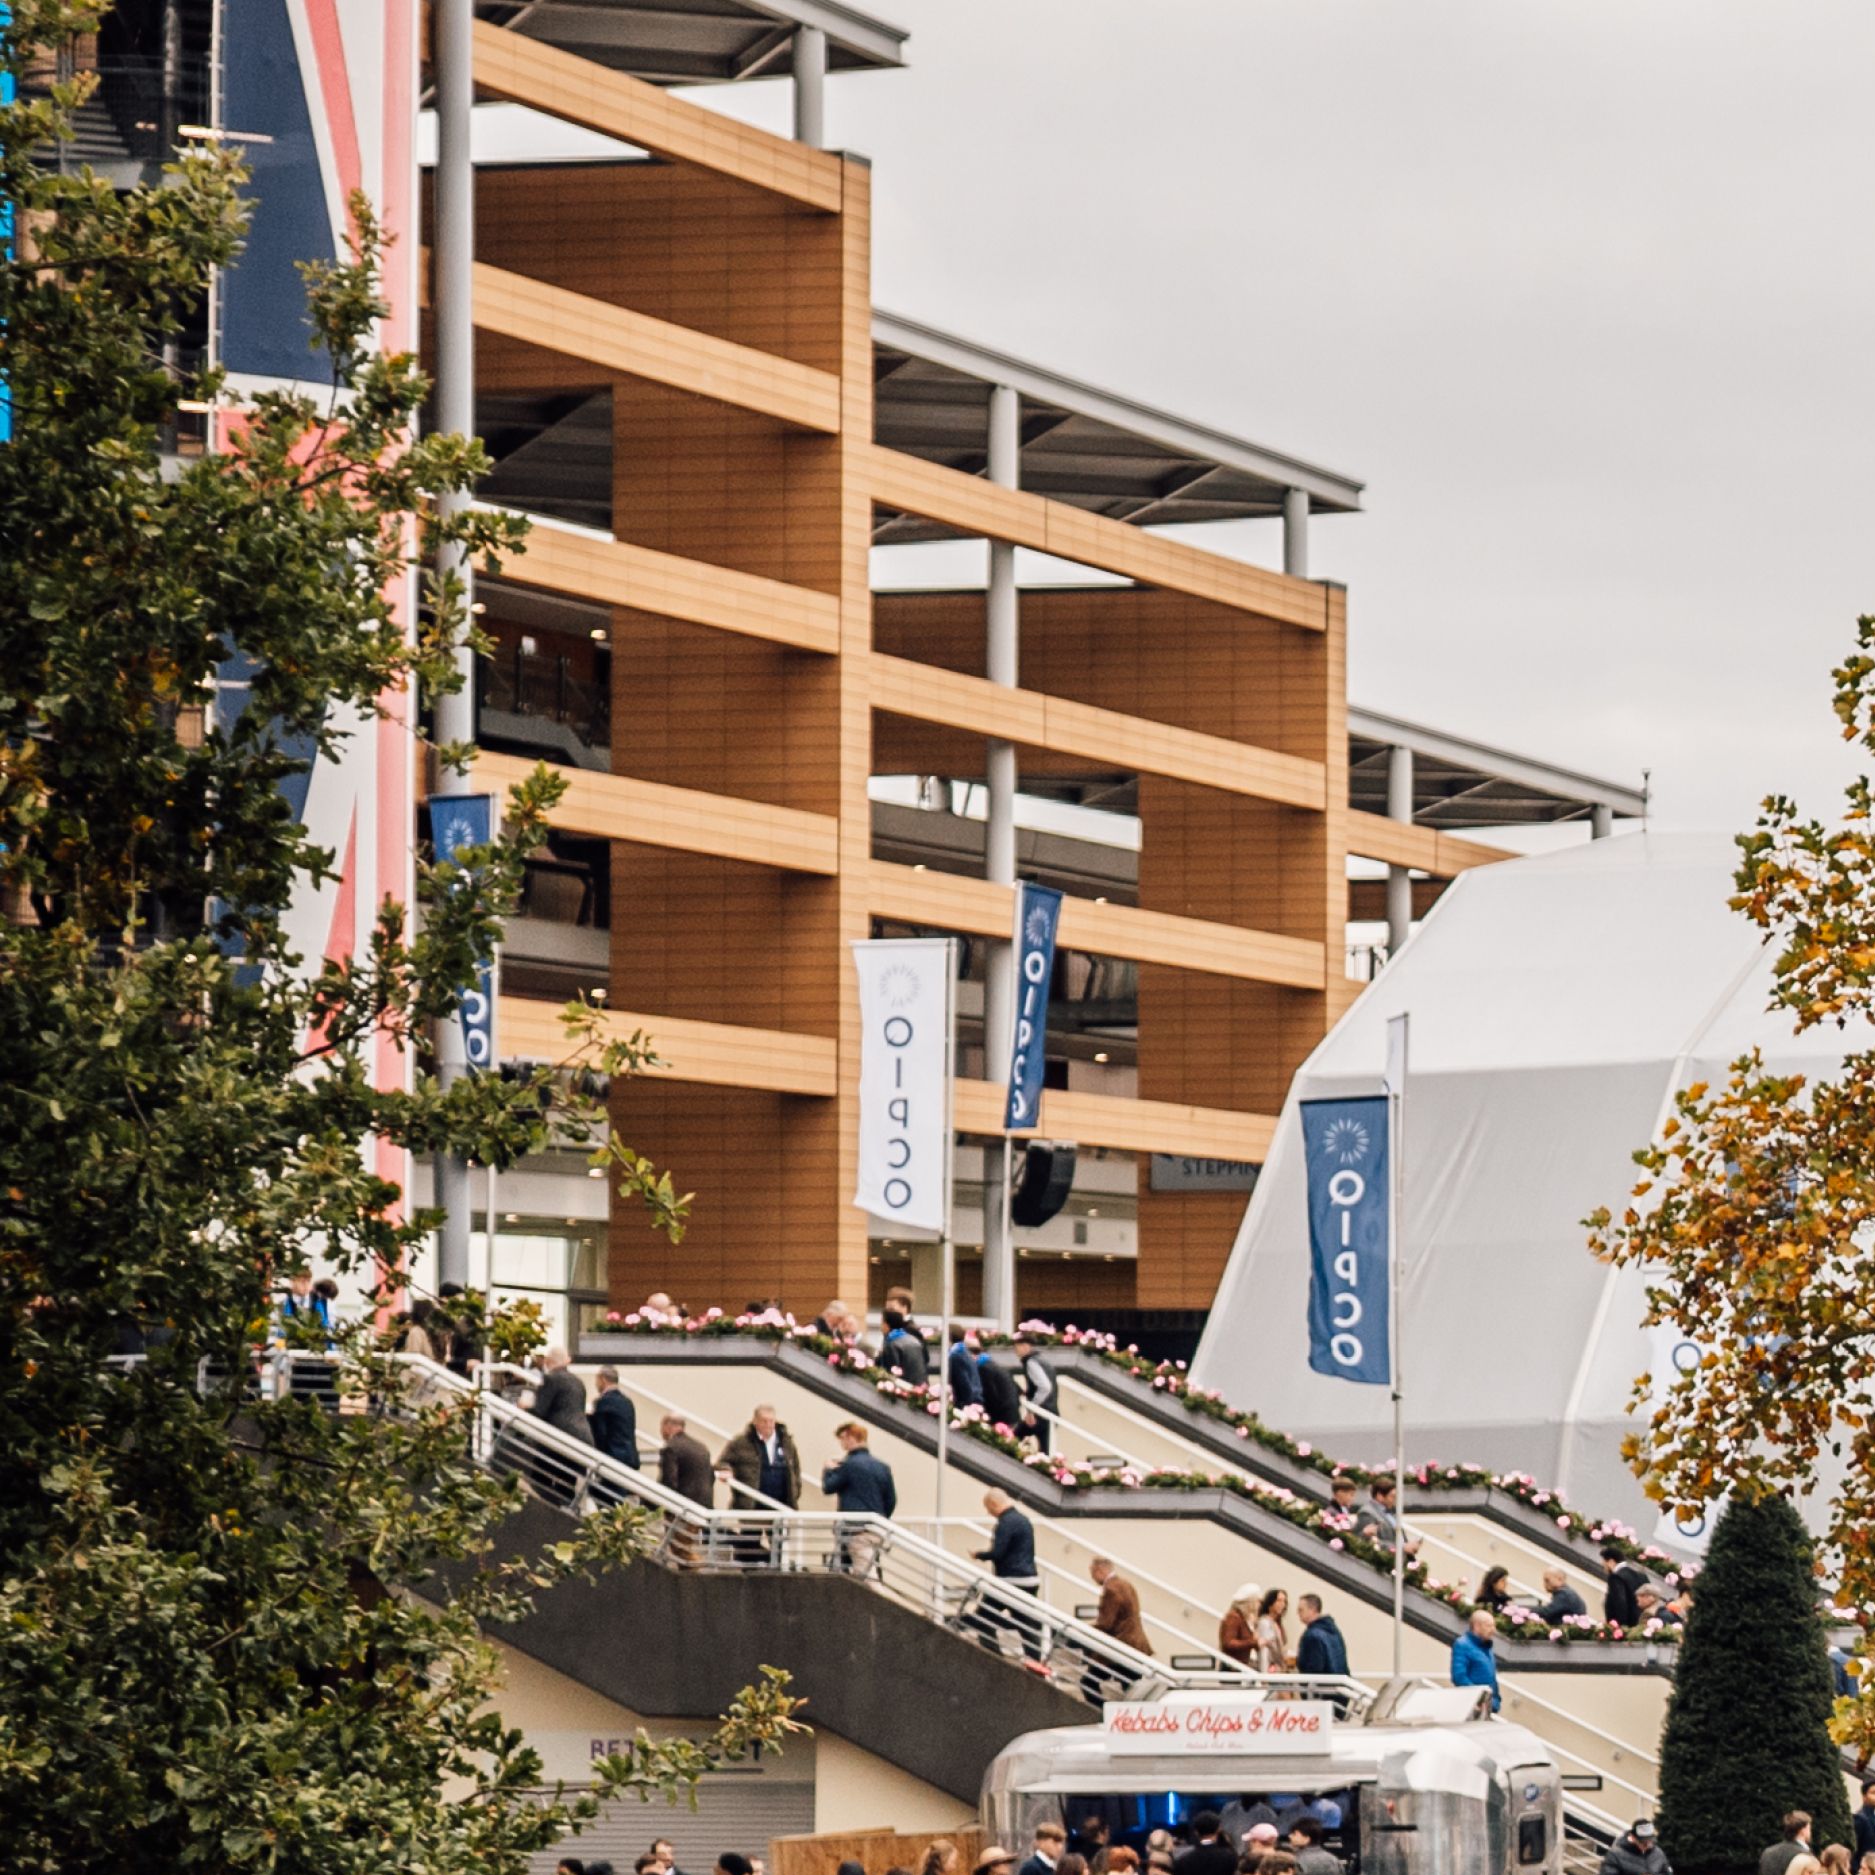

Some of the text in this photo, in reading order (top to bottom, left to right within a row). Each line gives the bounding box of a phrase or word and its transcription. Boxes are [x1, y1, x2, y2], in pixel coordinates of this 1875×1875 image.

[1110, 1706, 1320, 1739] Kebabs Chips & More
